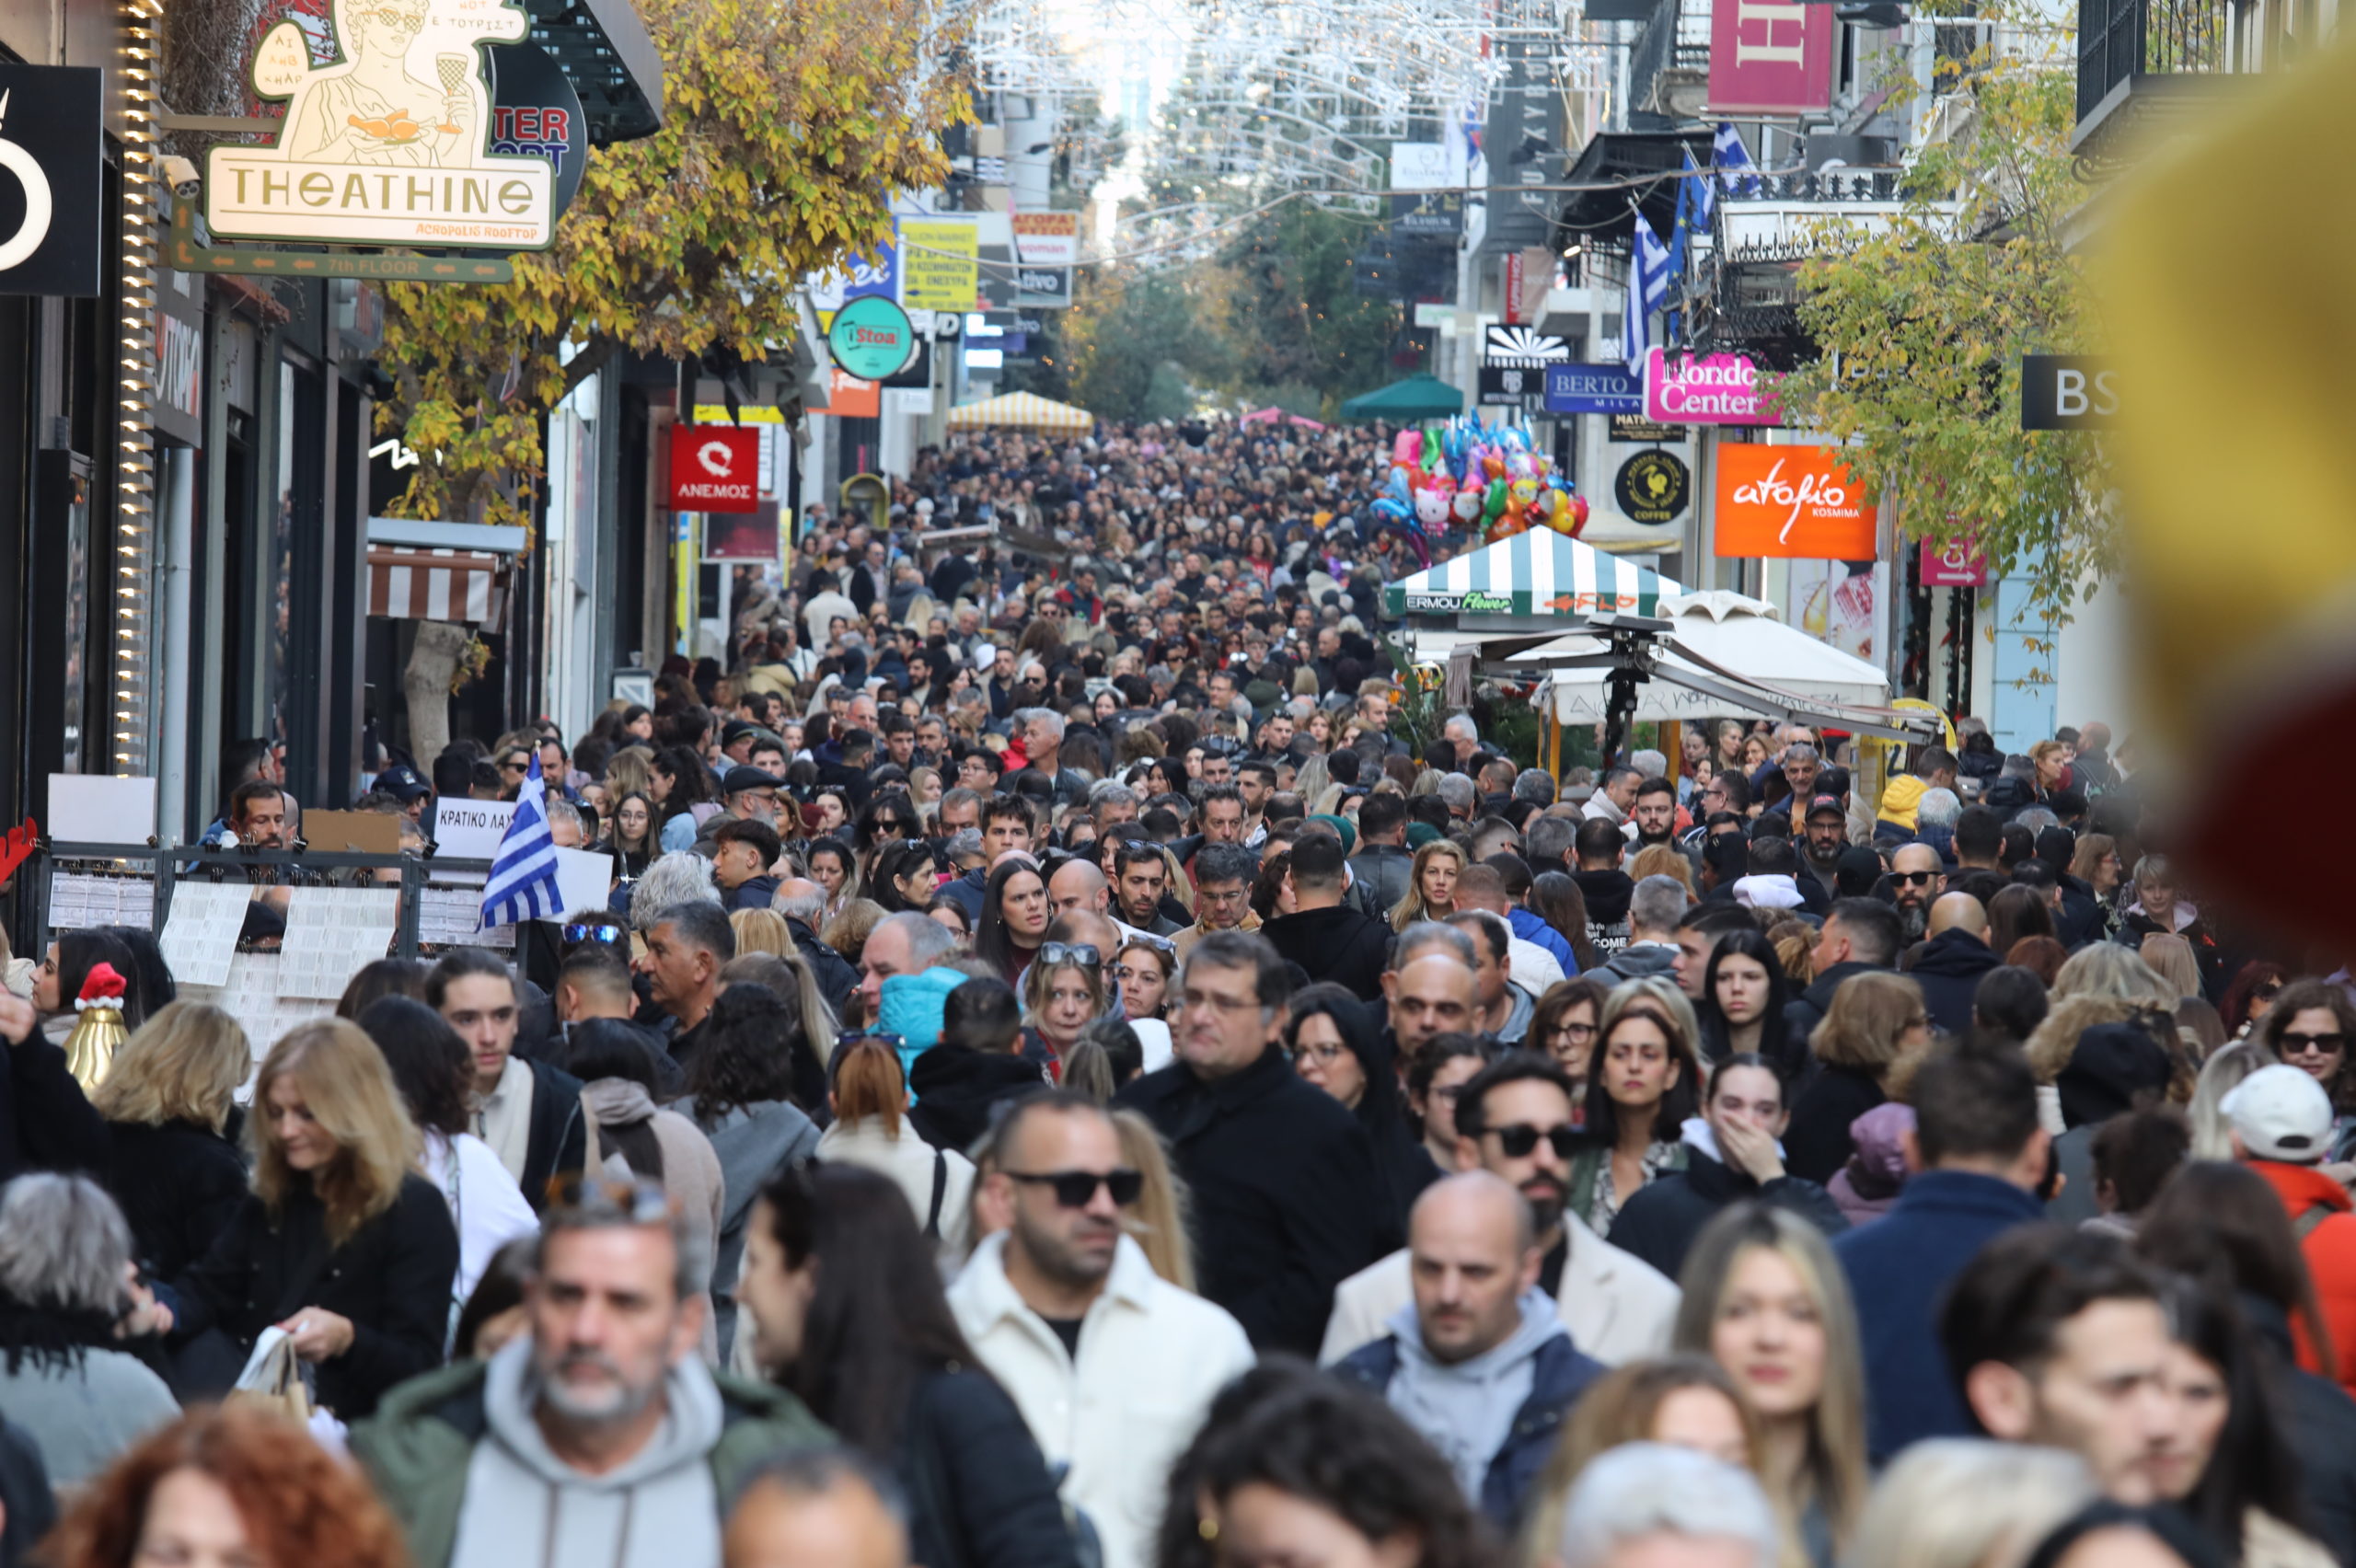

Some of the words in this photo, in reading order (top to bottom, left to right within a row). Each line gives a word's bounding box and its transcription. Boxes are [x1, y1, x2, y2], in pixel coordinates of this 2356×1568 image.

[416, 223, 482, 236] ACROPOLIS
[484, 226, 537, 239] ROOFTOP
[329, 259, 354, 272] 7th
[359, 260, 419, 273] FLOOR
[1556, 375, 1628, 393] BERTO
[1659, 384, 1761, 414] Center
[678, 484, 751, 498] ΑΝΕΜΟΣ
[1812, 507, 1860, 518] KOSMIMA
[1406, 596, 1461, 609] ERMOU
[1461, 592, 1510, 611] Flower
[440, 810, 486, 827] ΚΡΑΤΙΚΟ
